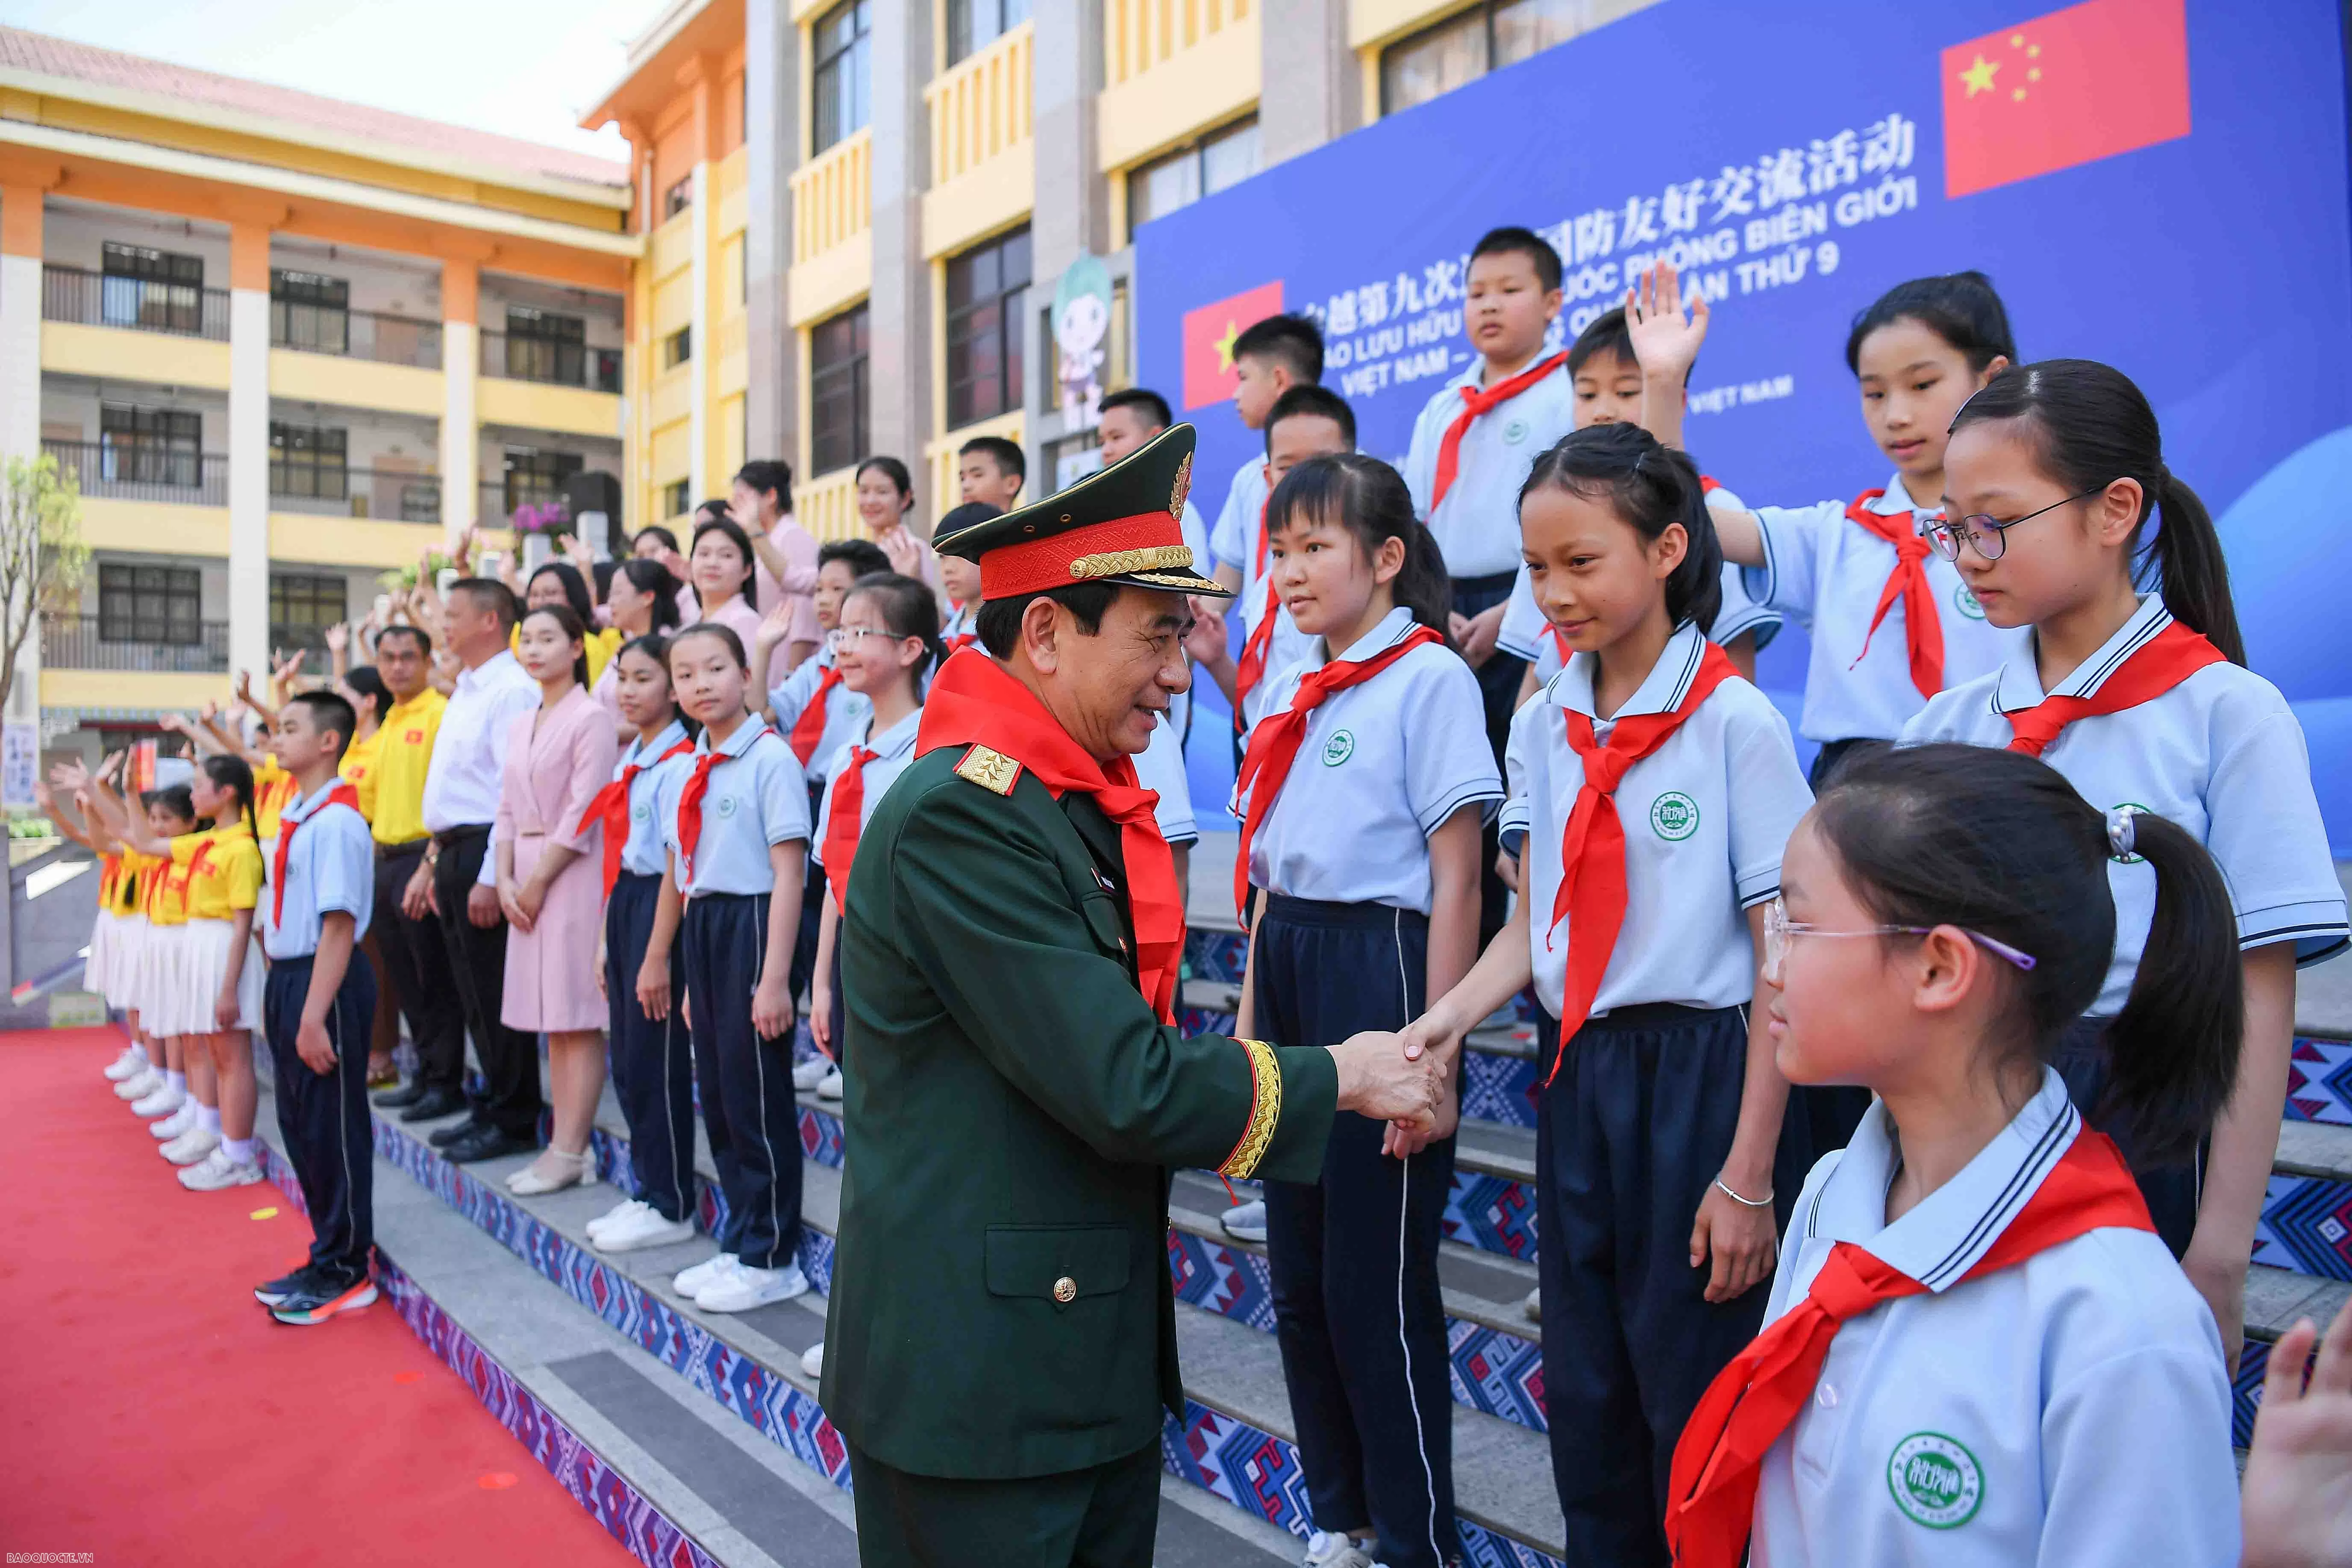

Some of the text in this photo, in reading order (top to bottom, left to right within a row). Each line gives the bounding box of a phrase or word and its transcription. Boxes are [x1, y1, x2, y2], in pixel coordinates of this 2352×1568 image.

[1744, 202, 1828, 253] BIÊN
[1835, 174, 1918, 227] GIỚI
[1340, 362, 1391, 397] VIỆT
[1394, 345, 1449, 384] NAM
[1816, 240, 1840, 276] 9
[1740, 374, 1794, 405] NAM
